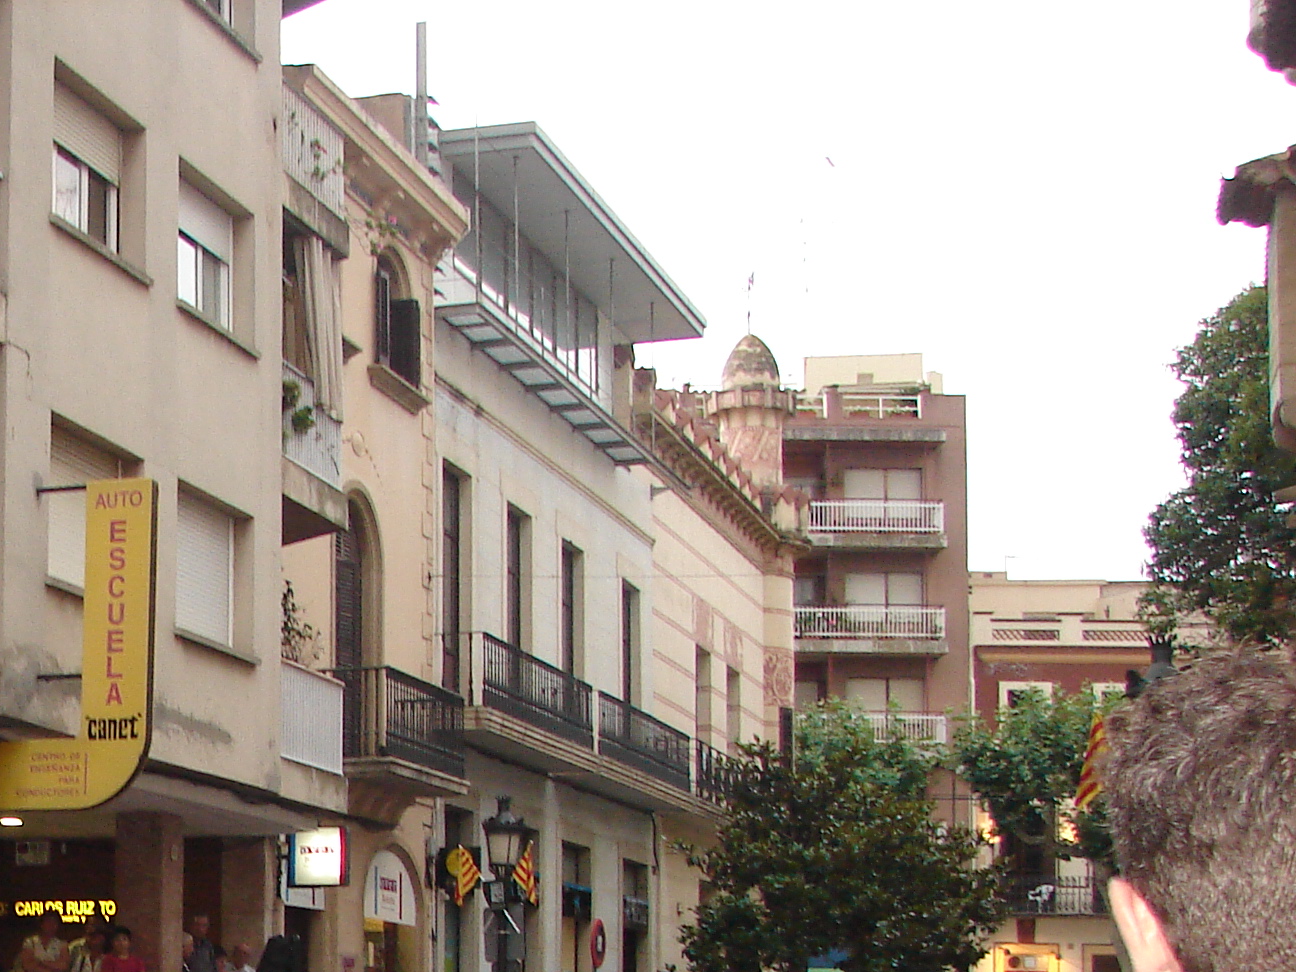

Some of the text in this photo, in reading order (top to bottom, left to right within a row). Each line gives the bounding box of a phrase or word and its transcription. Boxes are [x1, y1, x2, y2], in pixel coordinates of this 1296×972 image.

[95, 490, 143, 510] AUTO
[105, 520, 127, 706] ESCUELA
[65, 900, 96, 916] RUIZ
